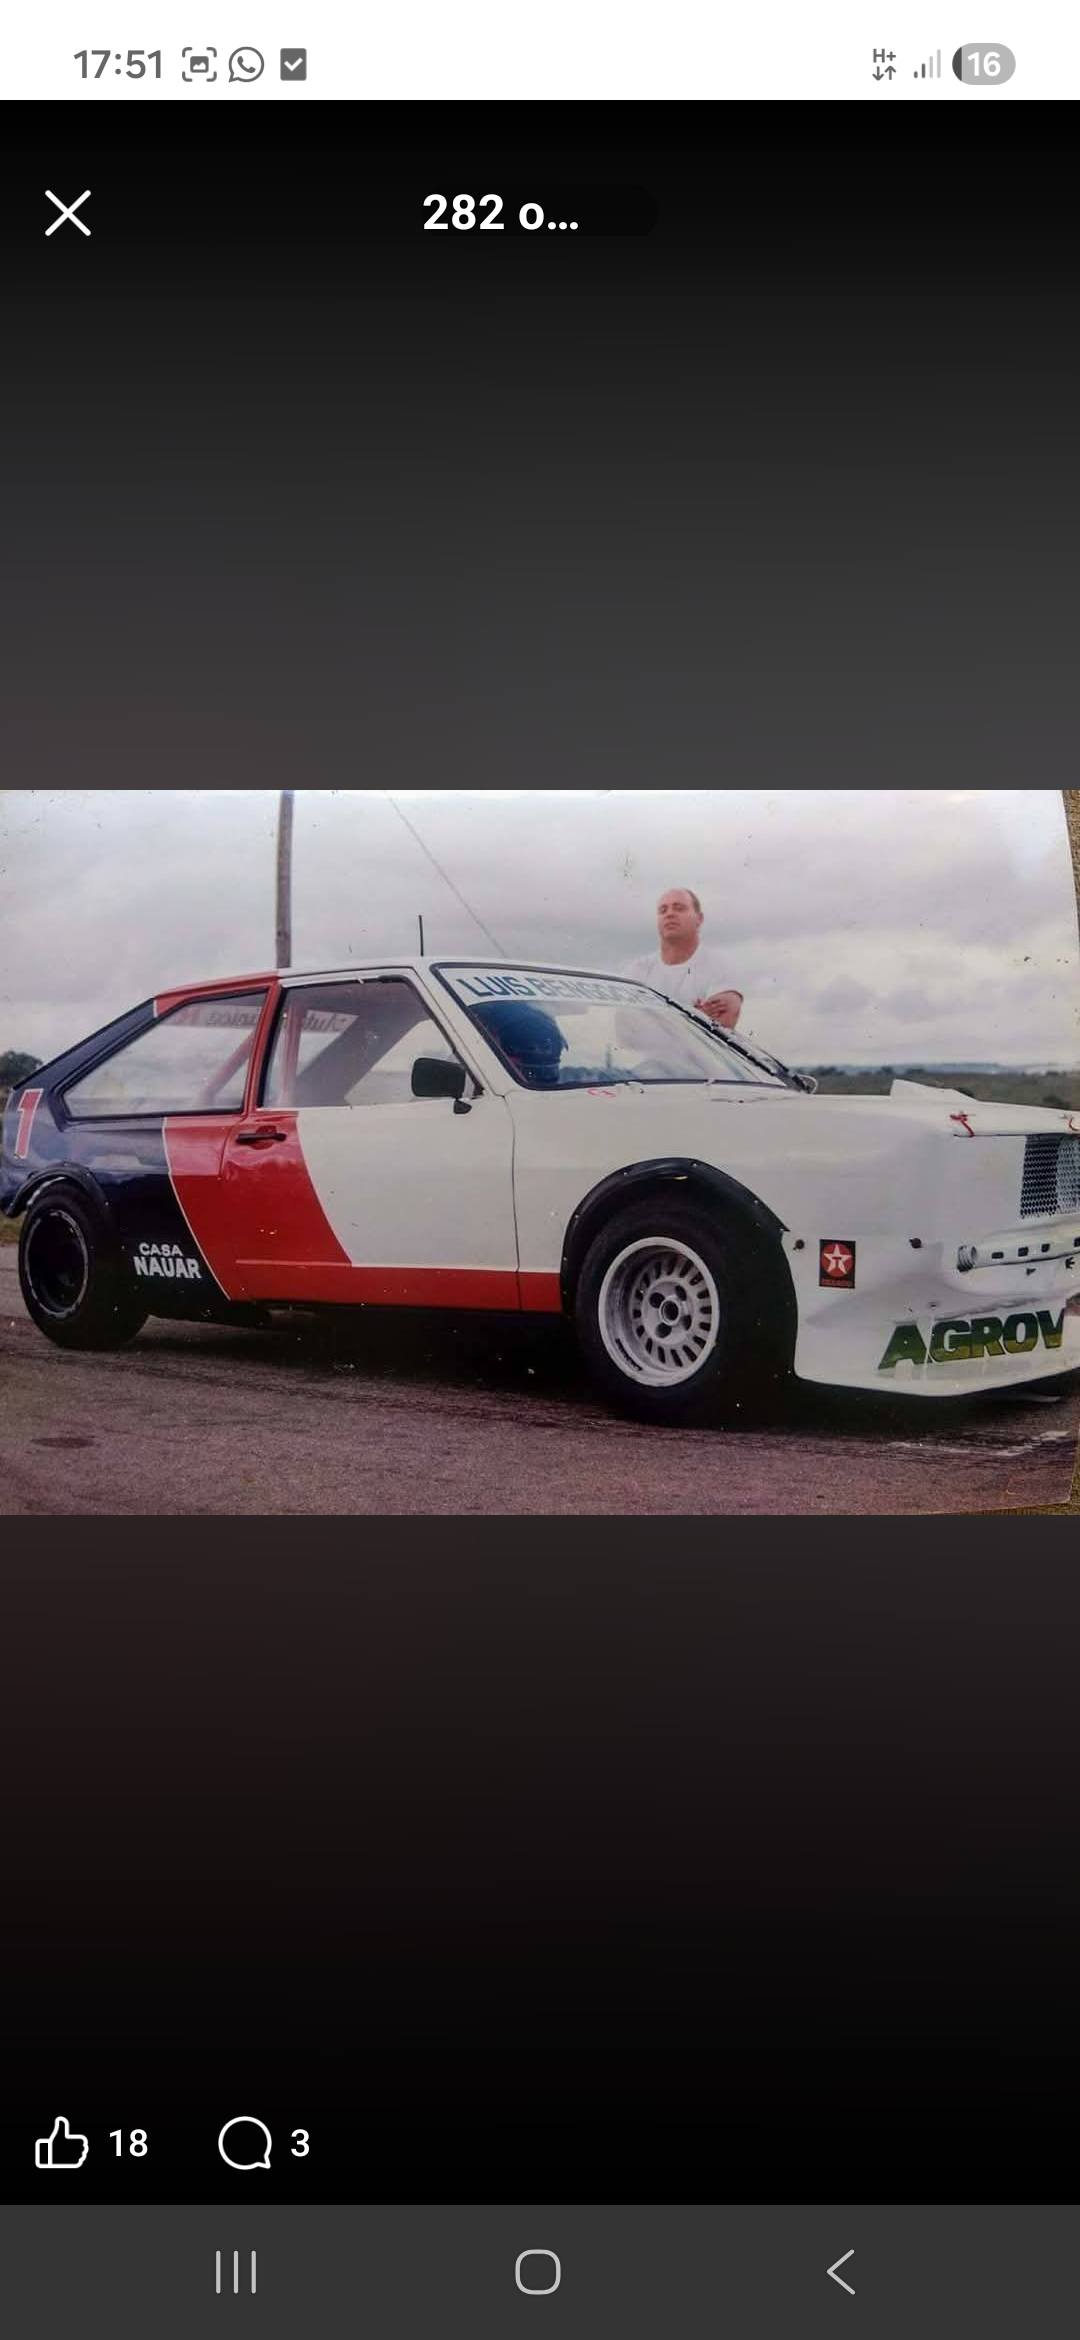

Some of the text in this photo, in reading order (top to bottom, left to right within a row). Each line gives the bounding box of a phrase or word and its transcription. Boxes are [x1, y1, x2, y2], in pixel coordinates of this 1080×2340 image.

[456, 976, 536, 999] LUIS
[14, 1088, 44, 1159] 1
[139, 1242, 184, 1257] CASA
[878, 1310, 1065, 1369] AGROV
